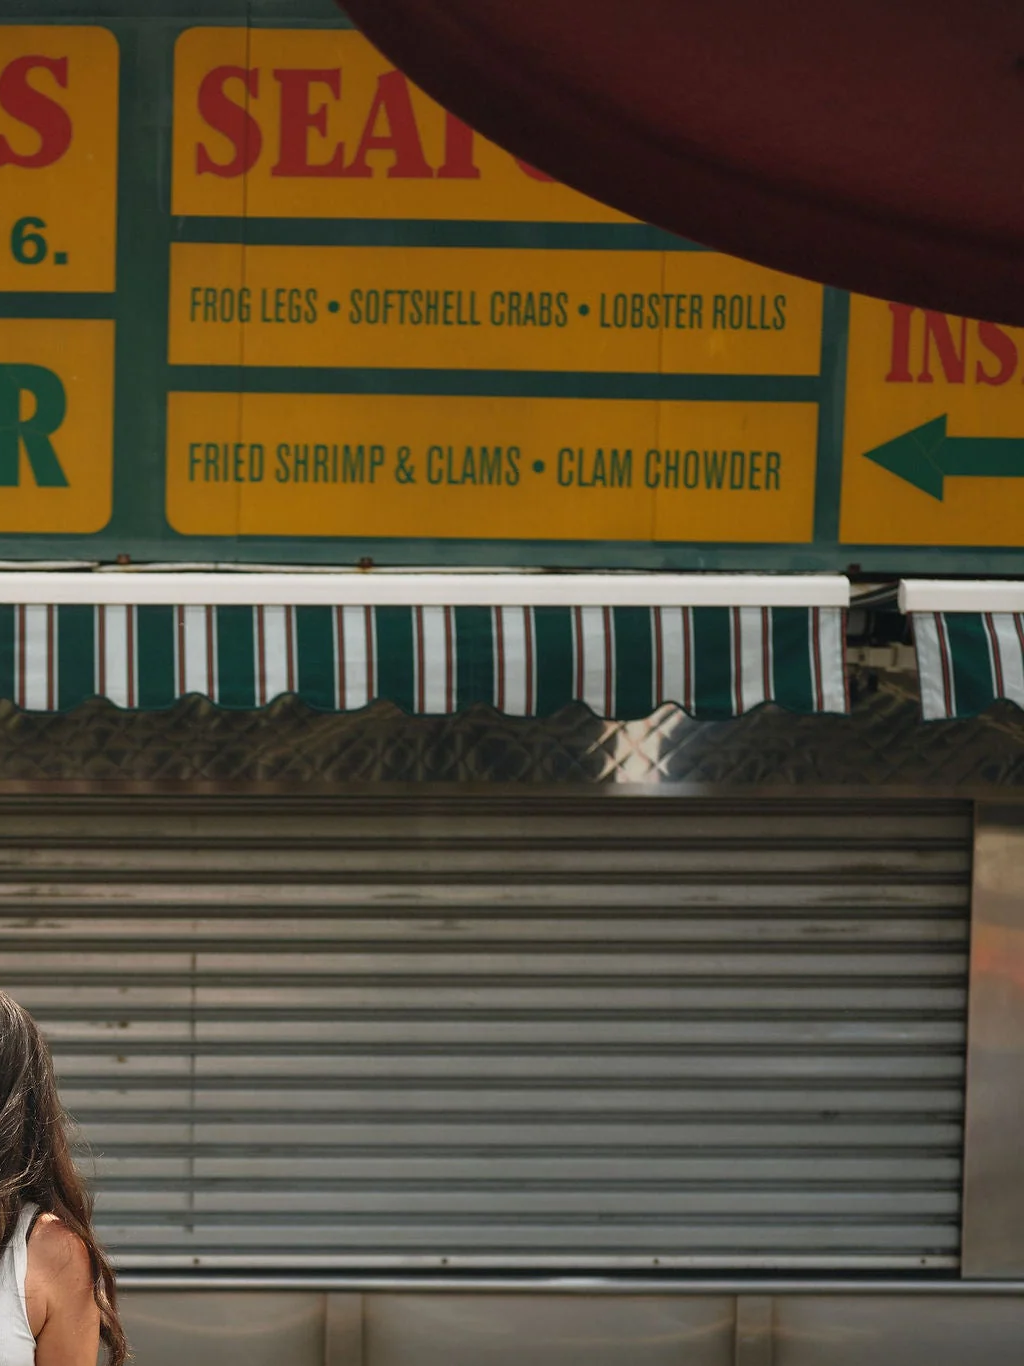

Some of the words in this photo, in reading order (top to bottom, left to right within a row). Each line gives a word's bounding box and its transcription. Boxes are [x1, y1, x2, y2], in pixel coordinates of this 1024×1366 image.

[189, 286, 251, 324] FROG
[260, 288, 318, 324] LEGS
[349, 288, 482, 326] SOFTSHELL
[489, 291, 569, 327] CRABS
[599, 292, 703, 330] LOBSTER
[711, 294, 787, 331] ROLLS
[884, 302, 1024, 388] INS
[188, 442, 265, 483] FRIED
[274, 443, 385, 484] SHRIMP
[394, 445, 416, 484] &
[426, 445, 521, 486] CLAMS
[556, 447, 633, 488] CLAM
[643, 448, 782, 491] CHOWDER
